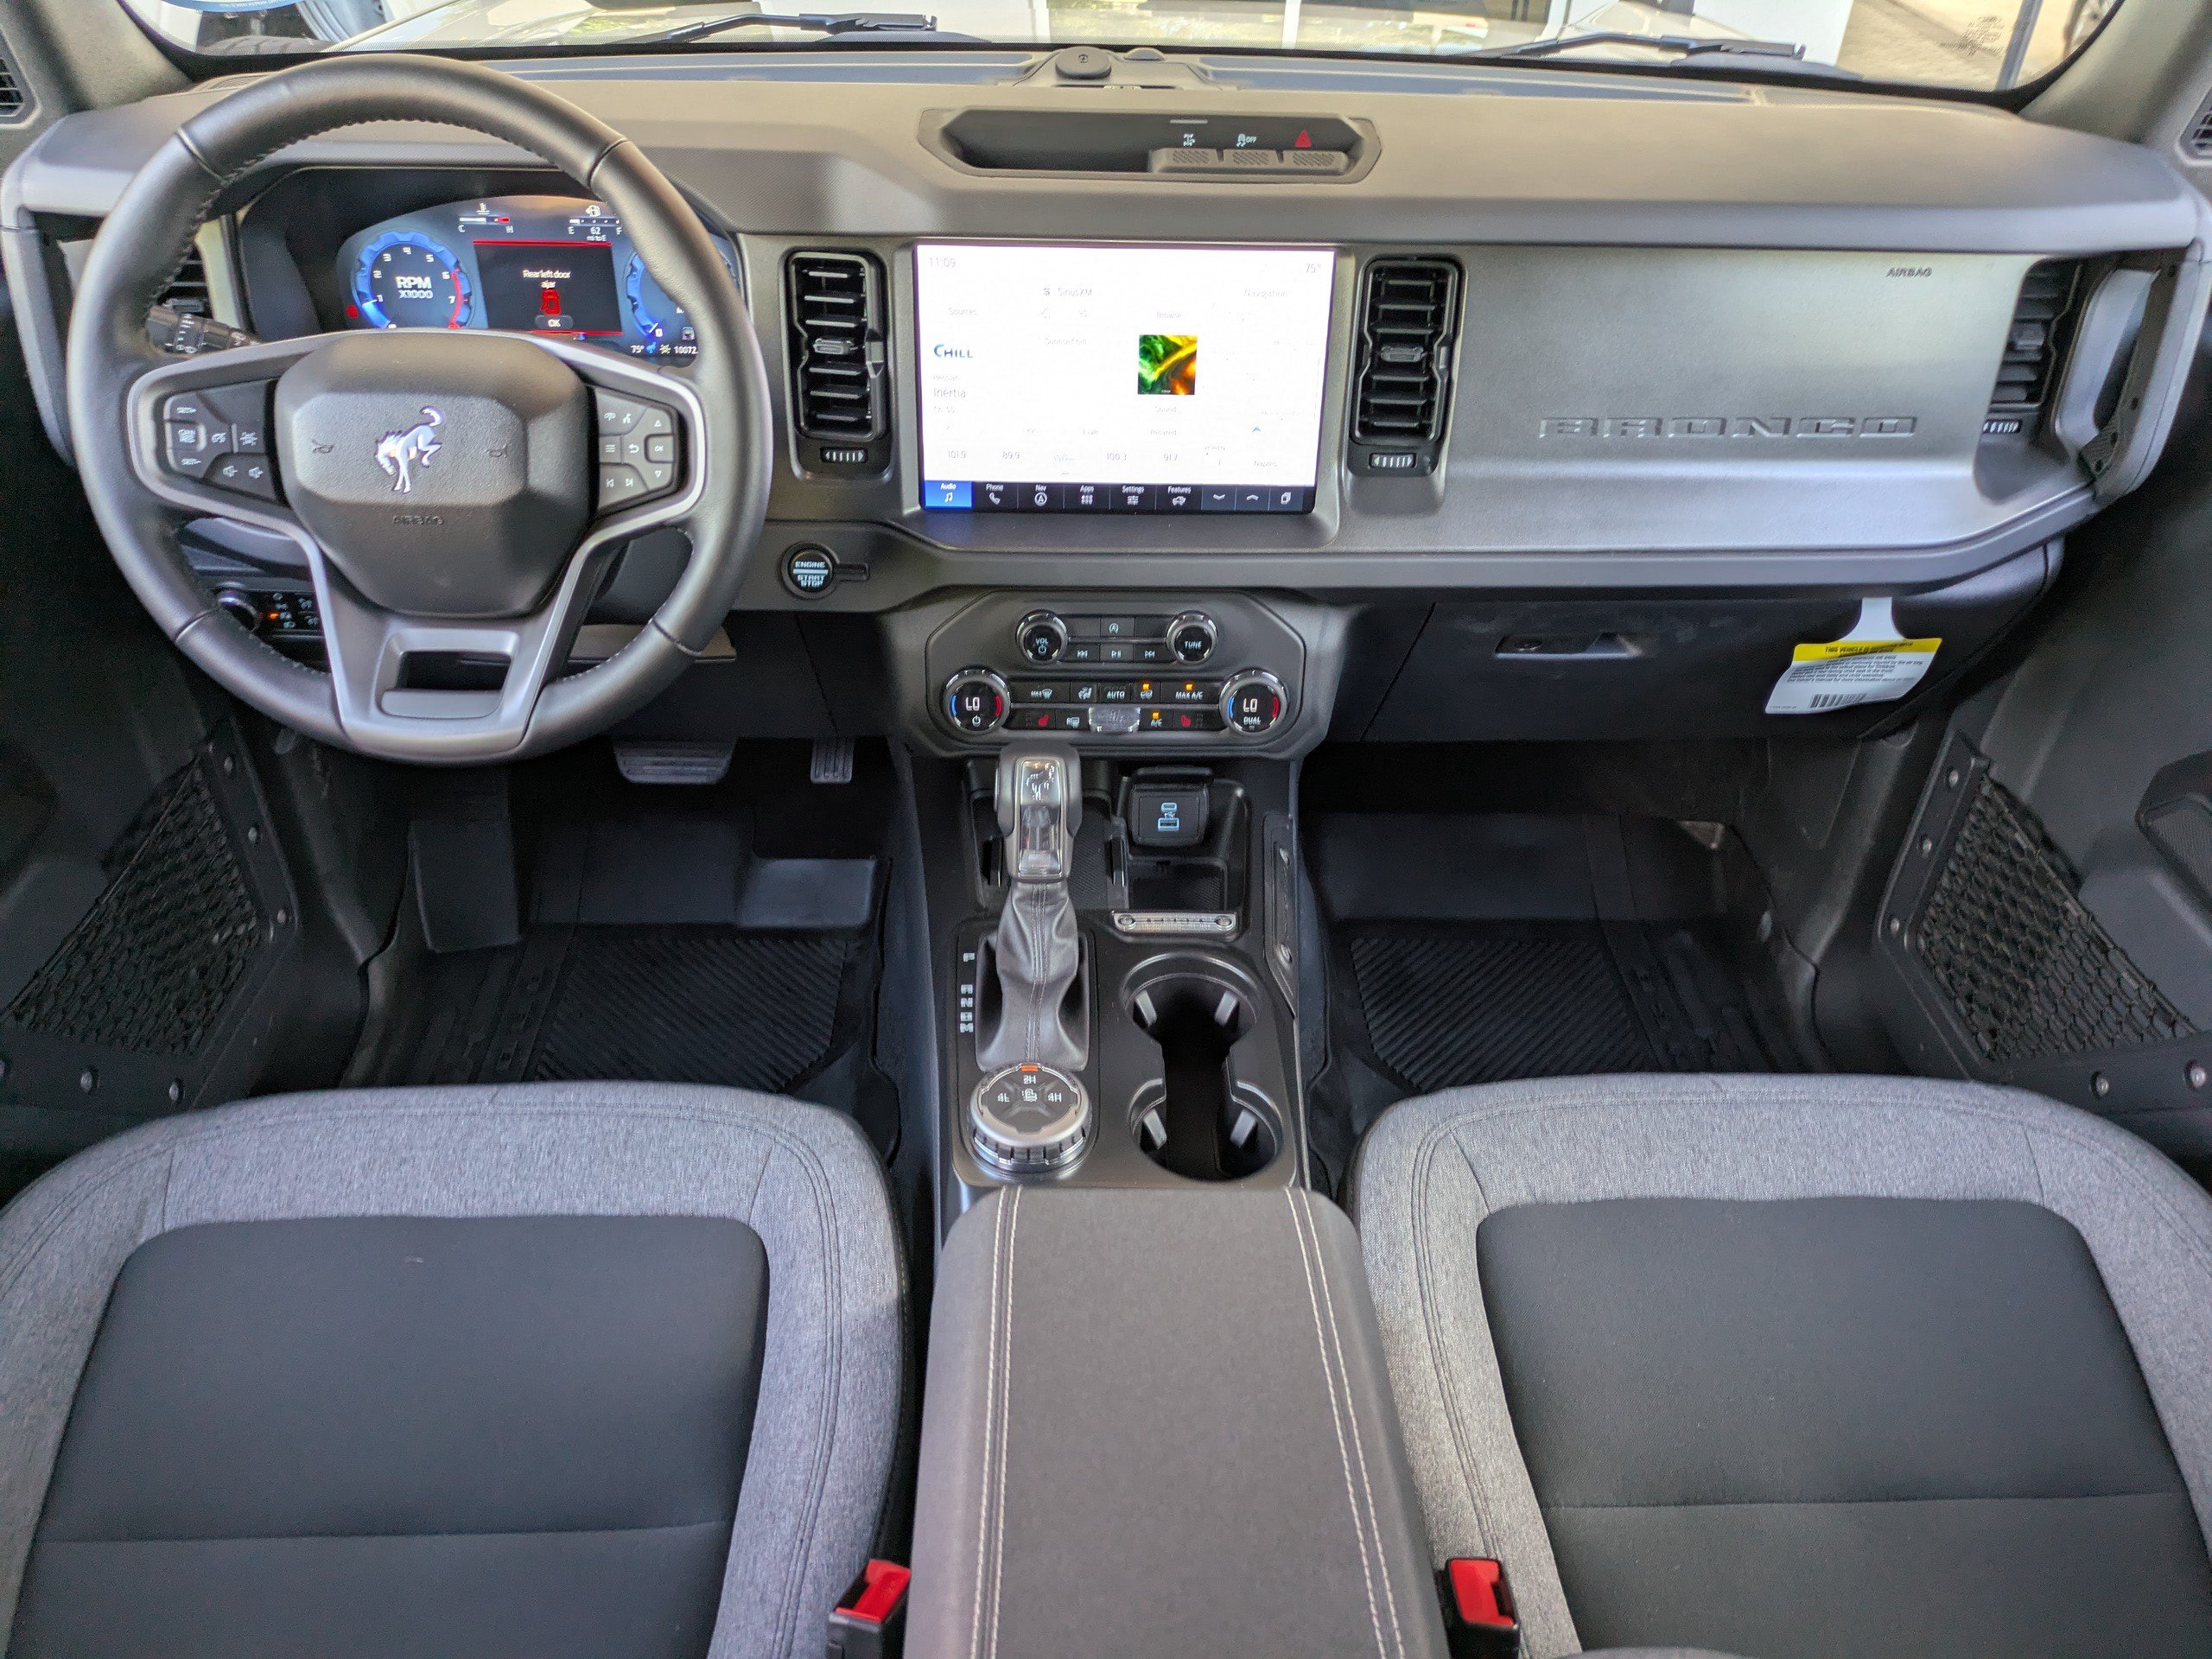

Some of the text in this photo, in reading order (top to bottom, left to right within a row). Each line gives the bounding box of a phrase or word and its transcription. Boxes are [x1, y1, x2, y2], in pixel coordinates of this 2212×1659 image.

[426, 254, 434, 263] 5
[523, 270, 570, 278] Rear left door
[1885, 267, 1932, 277] AIRBAG
[396, 276, 432, 289] RPM
[548, 319, 561, 327] OK
[1539, 416, 1918, 438] BRONCO
[1080, 485, 1094, 493] Apps
[1122, 486, 1145, 494] Settings
[1036, 637, 1049, 645] VOL
[1107, 691, 1125, 700] AUTO
[965, 696, 980, 711] LO
[1243, 698, 1258, 713] LO
[960, 997, 973, 1007] N
[960, 1023, 974, 1033] M
[1023, 1075, 1037, 1084] 2H
[997, 1093, 1010, 1103] 4L
[1047, 1092, 1062, 1103] 4H
